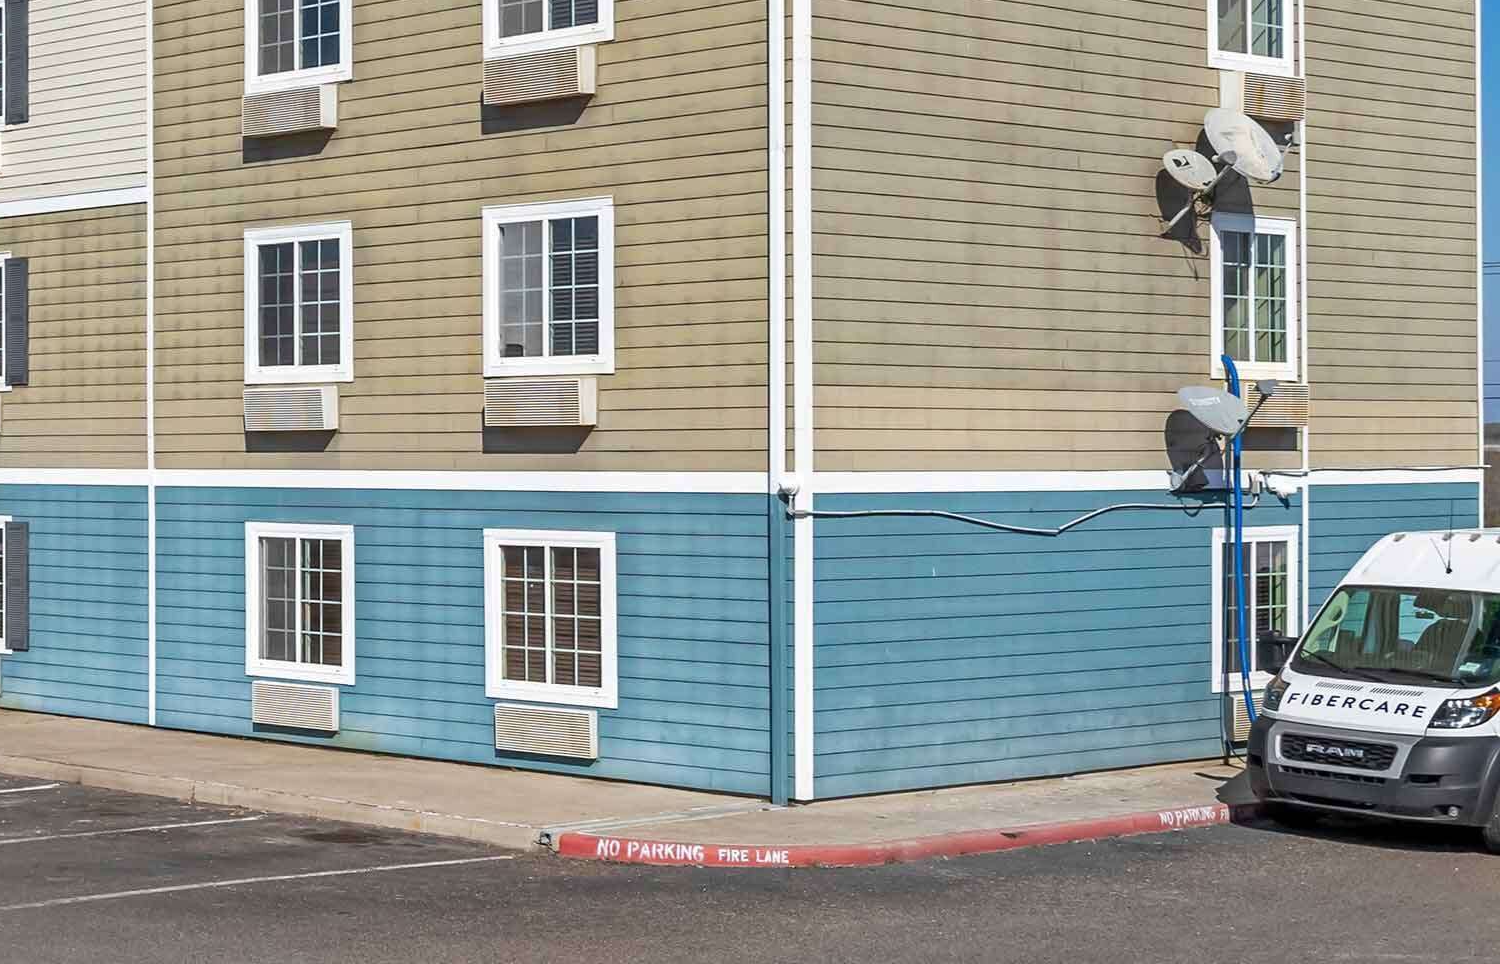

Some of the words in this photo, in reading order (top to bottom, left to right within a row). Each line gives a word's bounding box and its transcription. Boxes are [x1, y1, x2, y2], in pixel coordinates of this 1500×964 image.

[1287, 693, 1427, 718] FIBERCARE
[1306, 743, 1364, 757] RAM
[1159, 811, 1174, 825] NO
[1175, 806, 1216, 826] PARKING
[597, 839, 620, 856] NO
[627, 841, 704, 861] PARKING
[718, 849, 748, 862] FIRE
[756, 850, 789, 863] LANE
